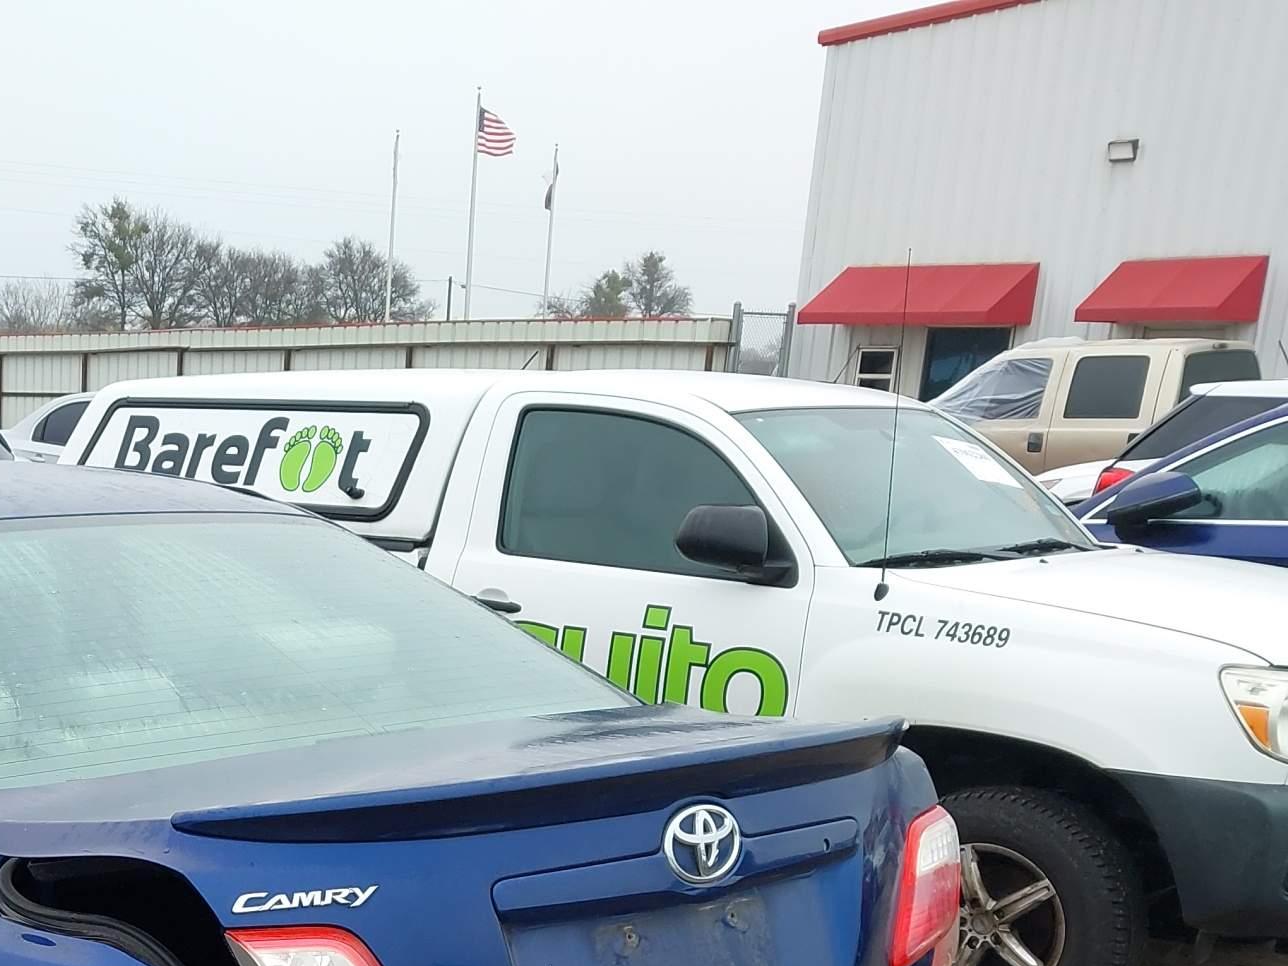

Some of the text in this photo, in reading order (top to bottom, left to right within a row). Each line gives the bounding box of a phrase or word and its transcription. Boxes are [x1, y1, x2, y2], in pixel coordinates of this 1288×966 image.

[876, 609, 1011, 649] TPCL 743689
[231, 884, 380, 915] CAMRY
